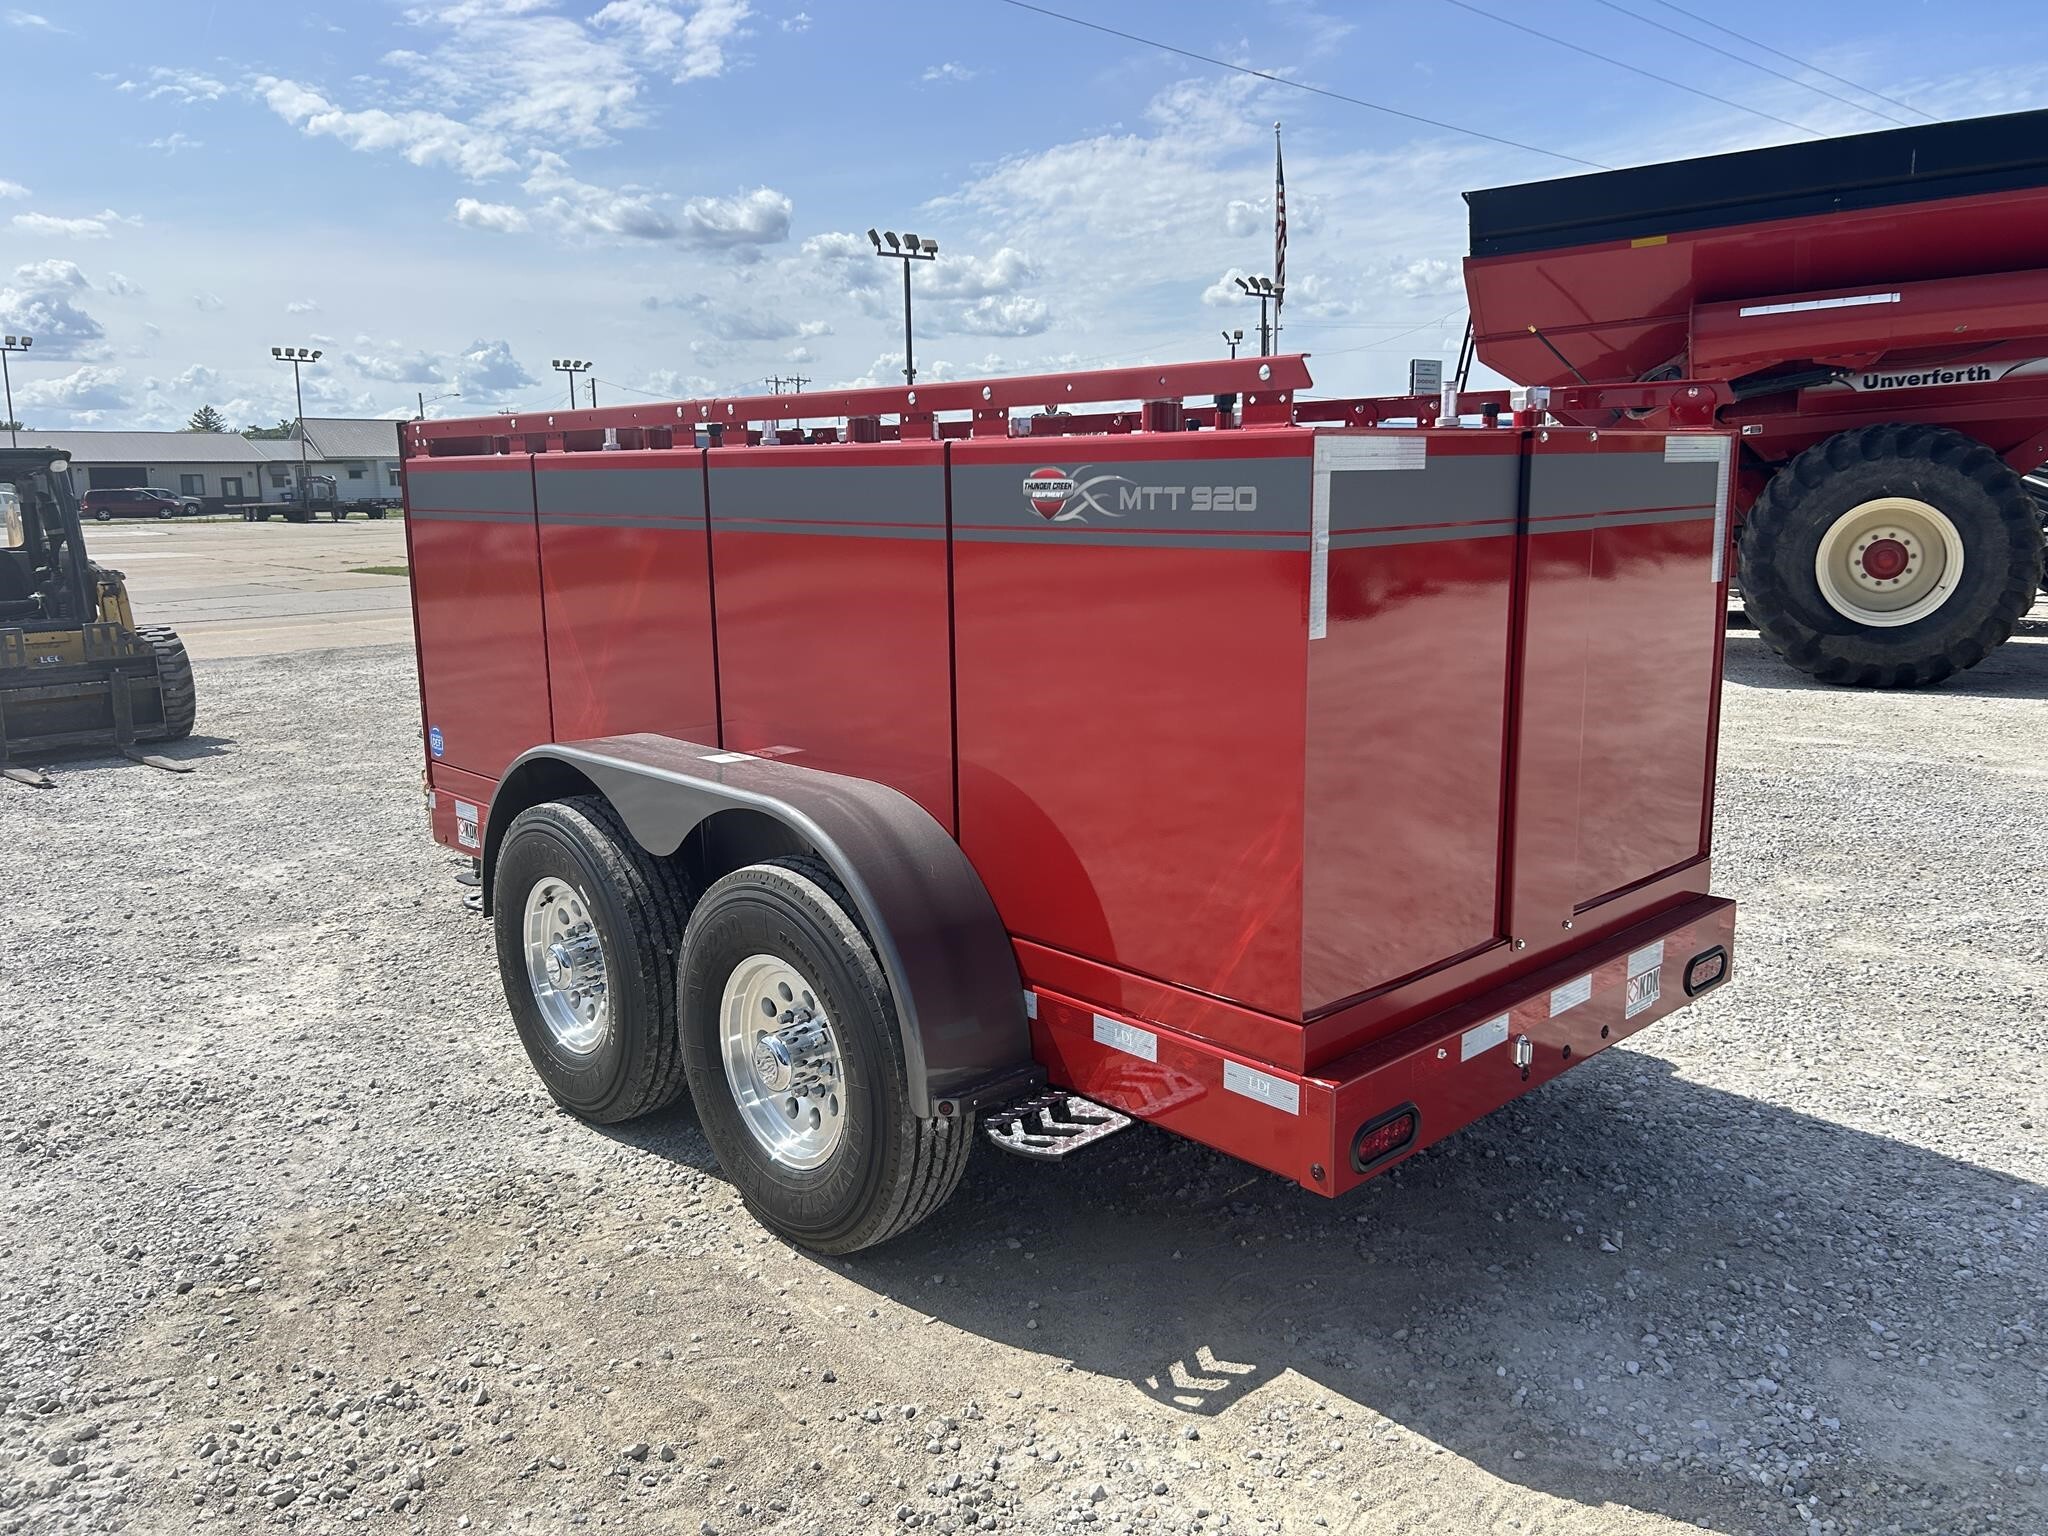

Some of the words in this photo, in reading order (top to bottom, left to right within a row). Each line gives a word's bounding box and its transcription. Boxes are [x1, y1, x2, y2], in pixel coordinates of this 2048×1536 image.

[1863, 366, 1991, 389] Unverferth
[1024, 482, 1052, 490] THUNDER
[1052, 482, 1073, 490] CREEK
[1119, 486, 1186, 511] MTT
[1190, 486, 1257, 512] 920
[1639, 968, 1660, 1001] KDK
